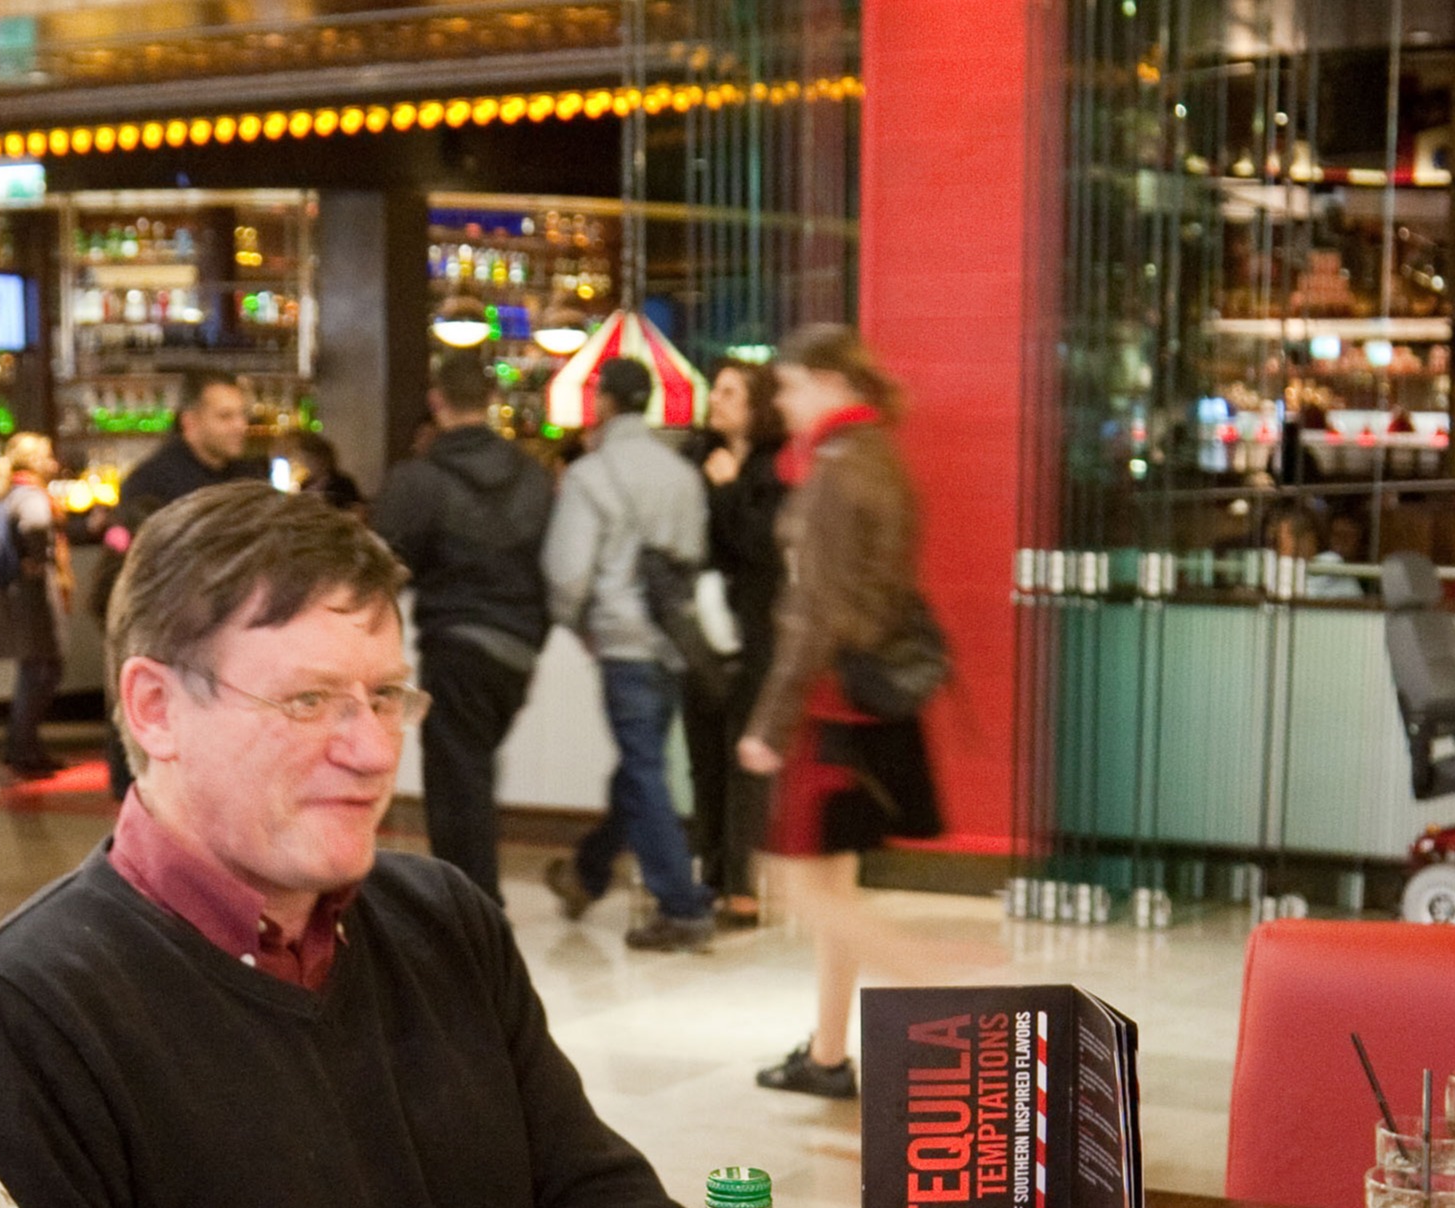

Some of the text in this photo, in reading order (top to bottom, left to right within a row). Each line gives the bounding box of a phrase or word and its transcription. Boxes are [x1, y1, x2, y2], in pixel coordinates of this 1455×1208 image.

[1015, 1011, 1032, 1069] FLAVORS
[977, 1012, 1010, 1198] TEMPTATIONS
[1014, 1071, 1030, 1134] INSPIRED
[1014, 1135, 1030, 1206] SOUTHERN
